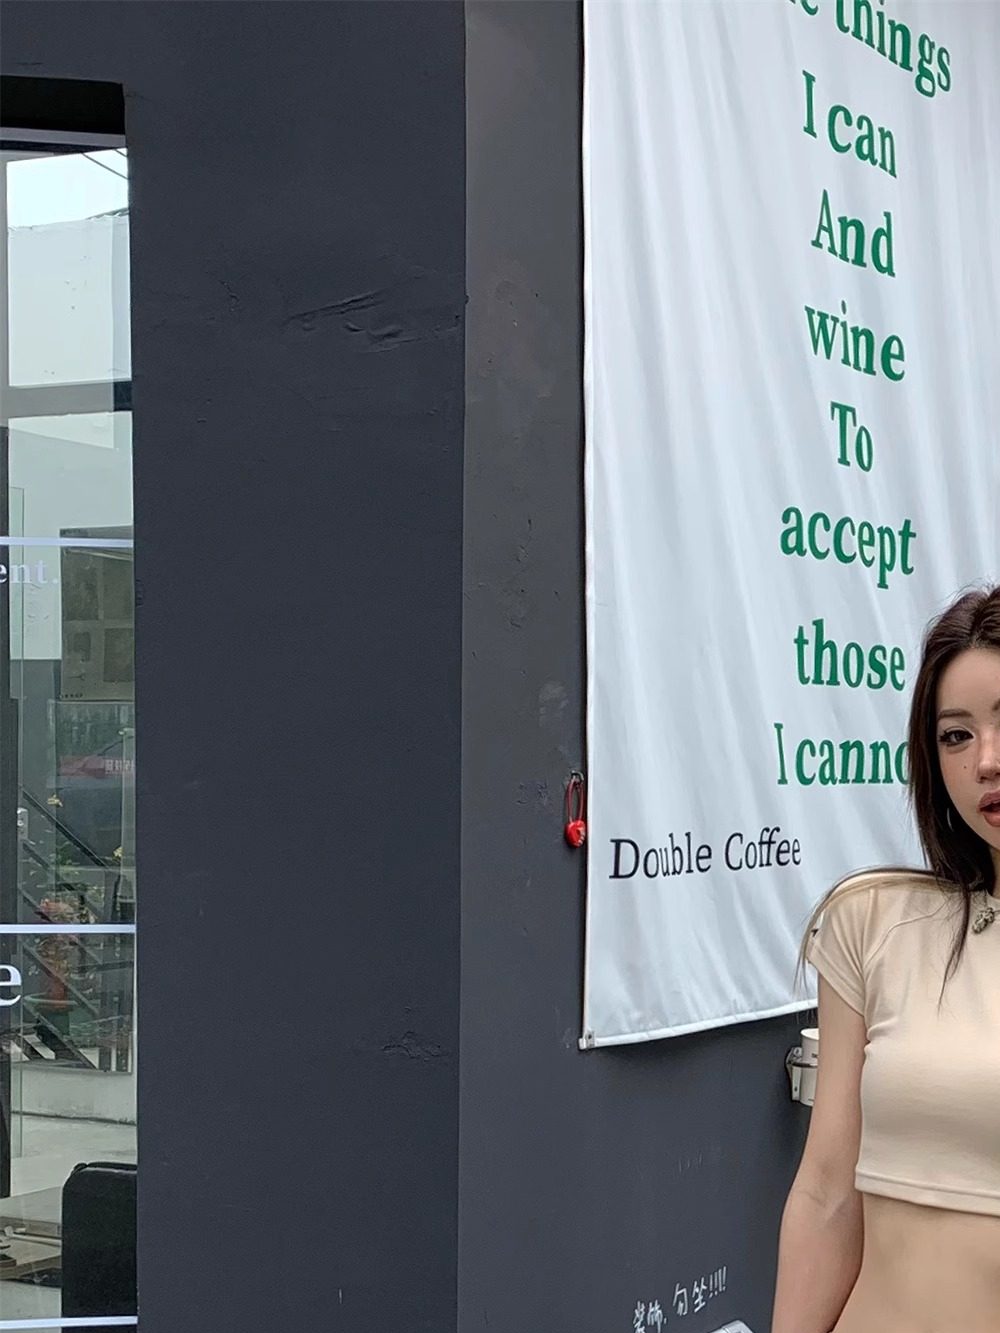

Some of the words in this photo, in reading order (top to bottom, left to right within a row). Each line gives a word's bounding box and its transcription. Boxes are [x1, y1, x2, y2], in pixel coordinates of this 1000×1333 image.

[836, 0, 951, 97] things
[802, 70, 816, 138] I
[828, 104, 897, 178] can
[811, 189, 896, 277] And
[805, 300, 905, 382] wine
[831, 401, 873, 471] To
[780, 506, 916, 589] accept
[794, 618, 906, 691] those
[774, 723, 788, 785] I
[609, 832, 712, 879] Double
[725, 826, 801, 871] Coffee
